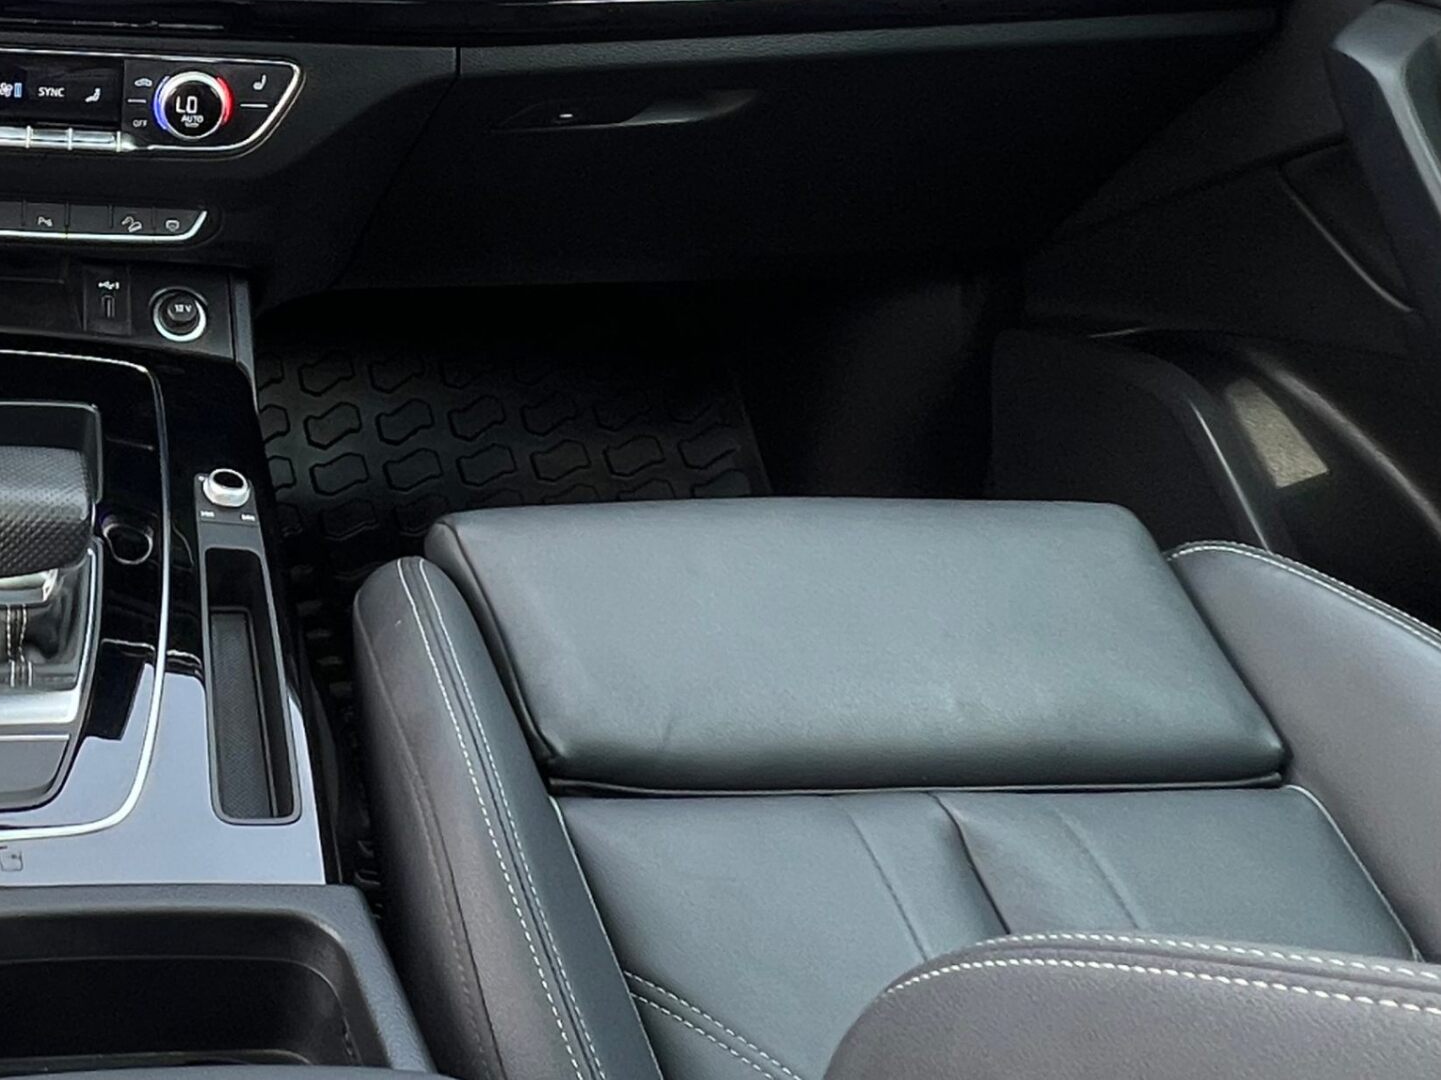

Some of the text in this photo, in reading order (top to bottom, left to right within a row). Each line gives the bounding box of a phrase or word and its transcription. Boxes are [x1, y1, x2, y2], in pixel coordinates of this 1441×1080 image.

[38, 87, 65, 97] SYNC
[132, 119, 147, 127] OFF
[181, 115, 204, 123] AUTO
